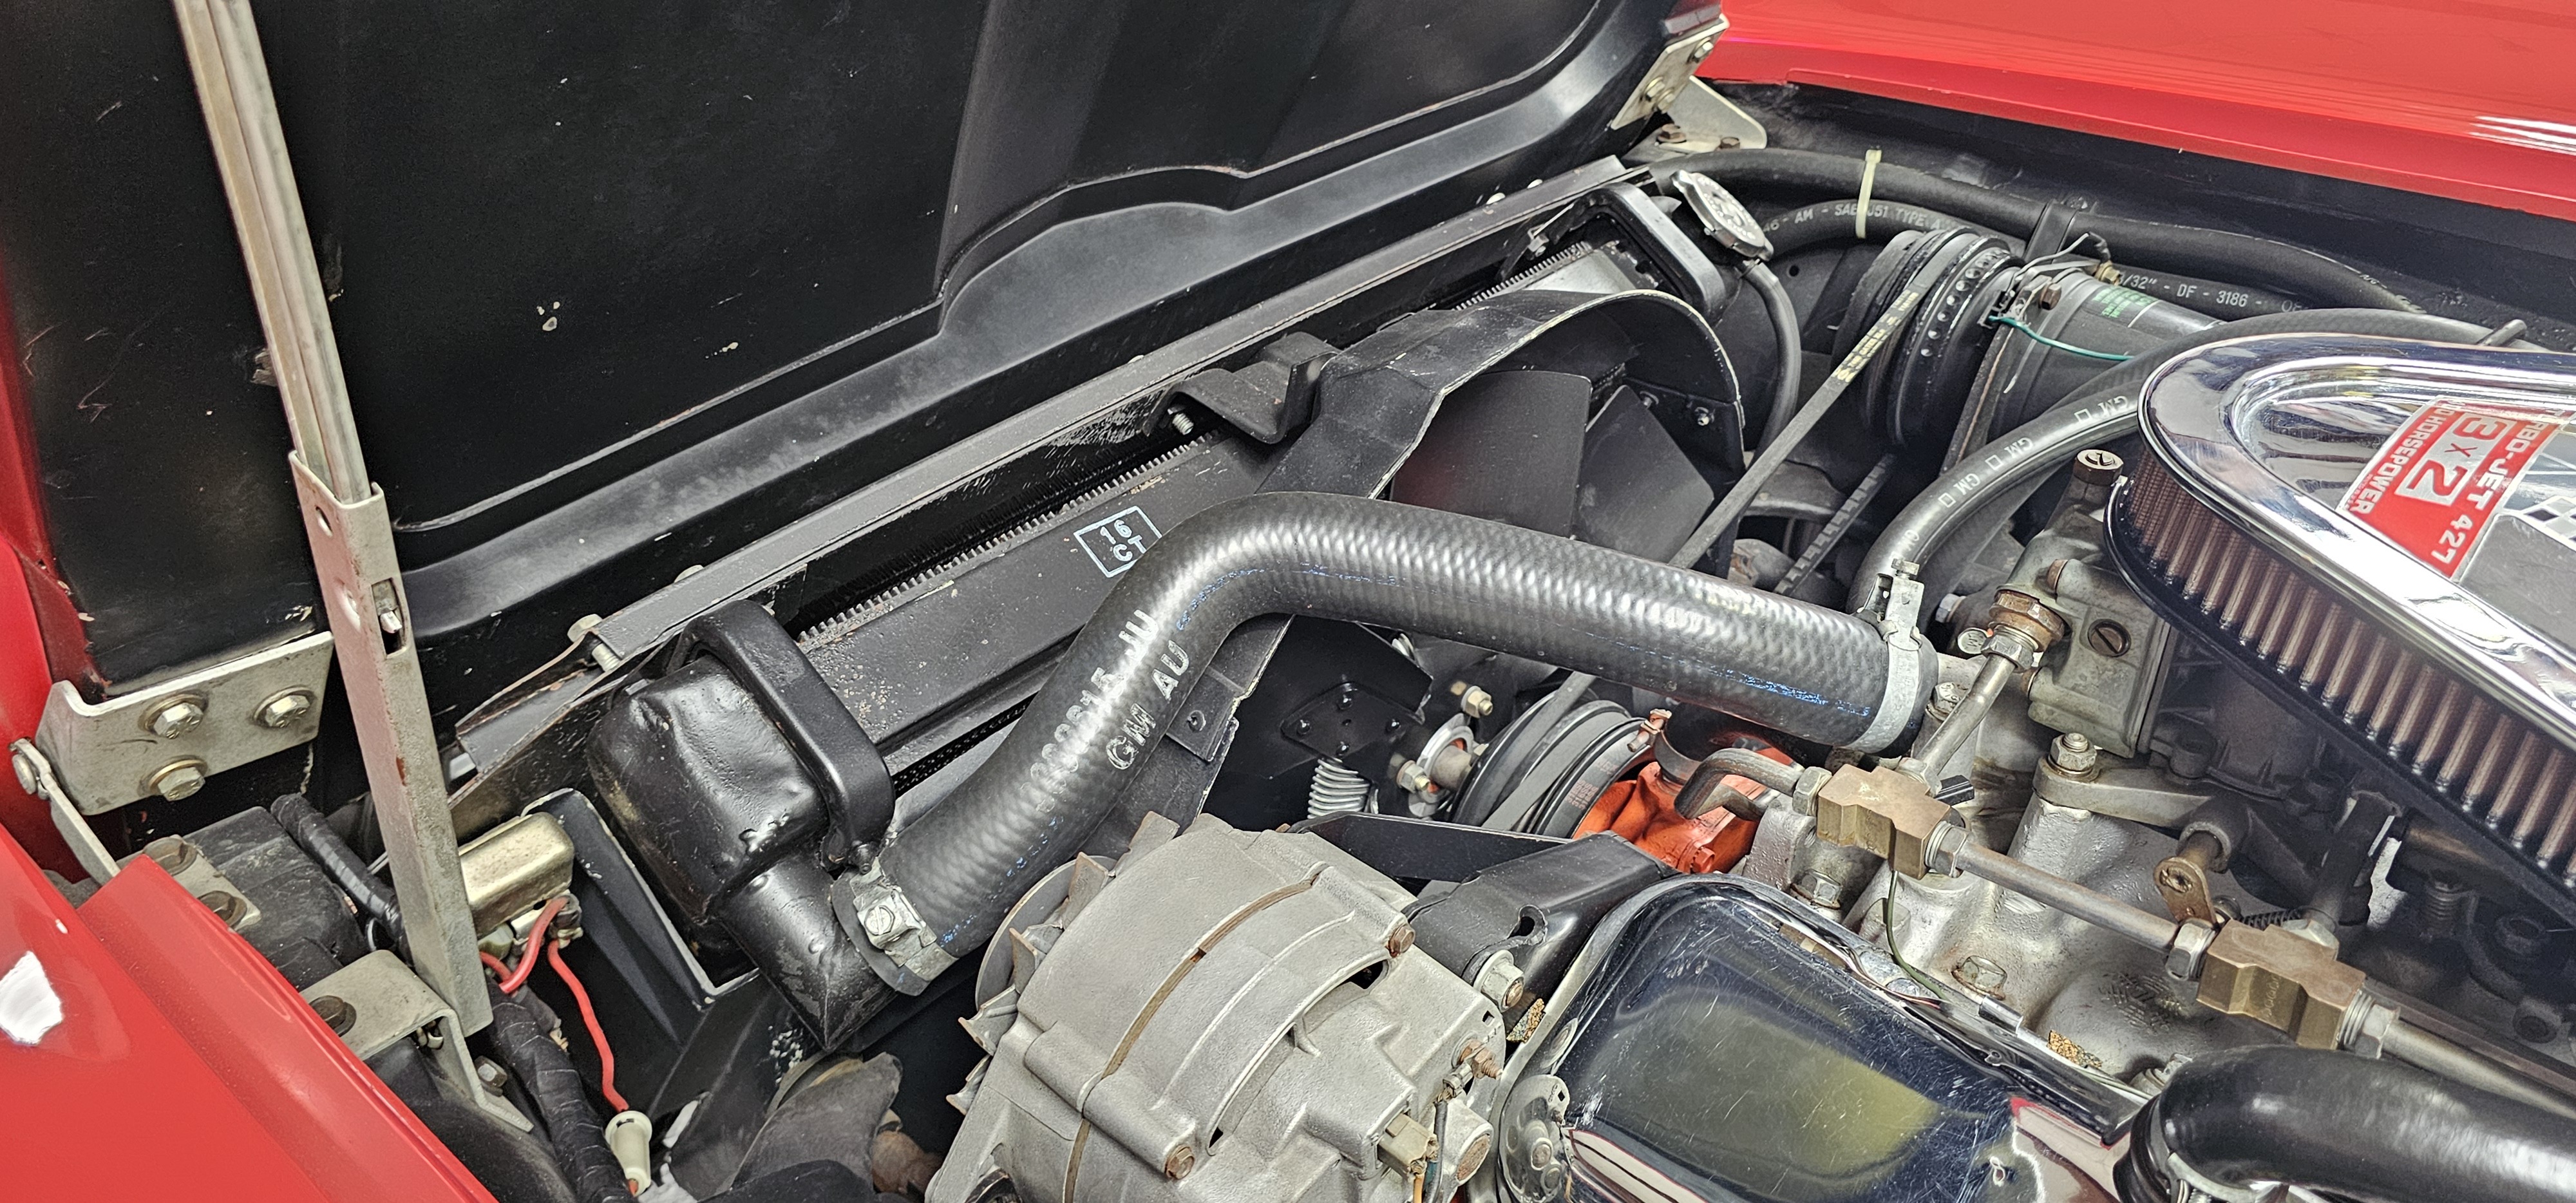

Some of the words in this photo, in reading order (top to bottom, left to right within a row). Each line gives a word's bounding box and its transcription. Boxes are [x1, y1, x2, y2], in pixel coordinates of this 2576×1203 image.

[1834, 203, 1857, 216] SAE
[1895, 207, 1927, 227] TYPE
[2177, 283, 2198, 298] DF
[2216, 290, 2249, 308] 3186
[2096, 395, 2128, 416] GM
[2453, 417, 2508, 440] 3
[2004, 437, 2034, 459] GM
[2349, 415, 2448, 514] HORSEPOWER
[1952, 473, 1981, 496] GM
[2407, 459, 2468, 497] 2
[1099, 519, 1133, 545] 16
[2430, 513, 2476, 564] 427
[1113, 534, 1147, 562] CT
[1118, 609, 1159, 660] JU
[1105, 703, 1157, 770] GM
[1151, 639, 1190, 702] AU
